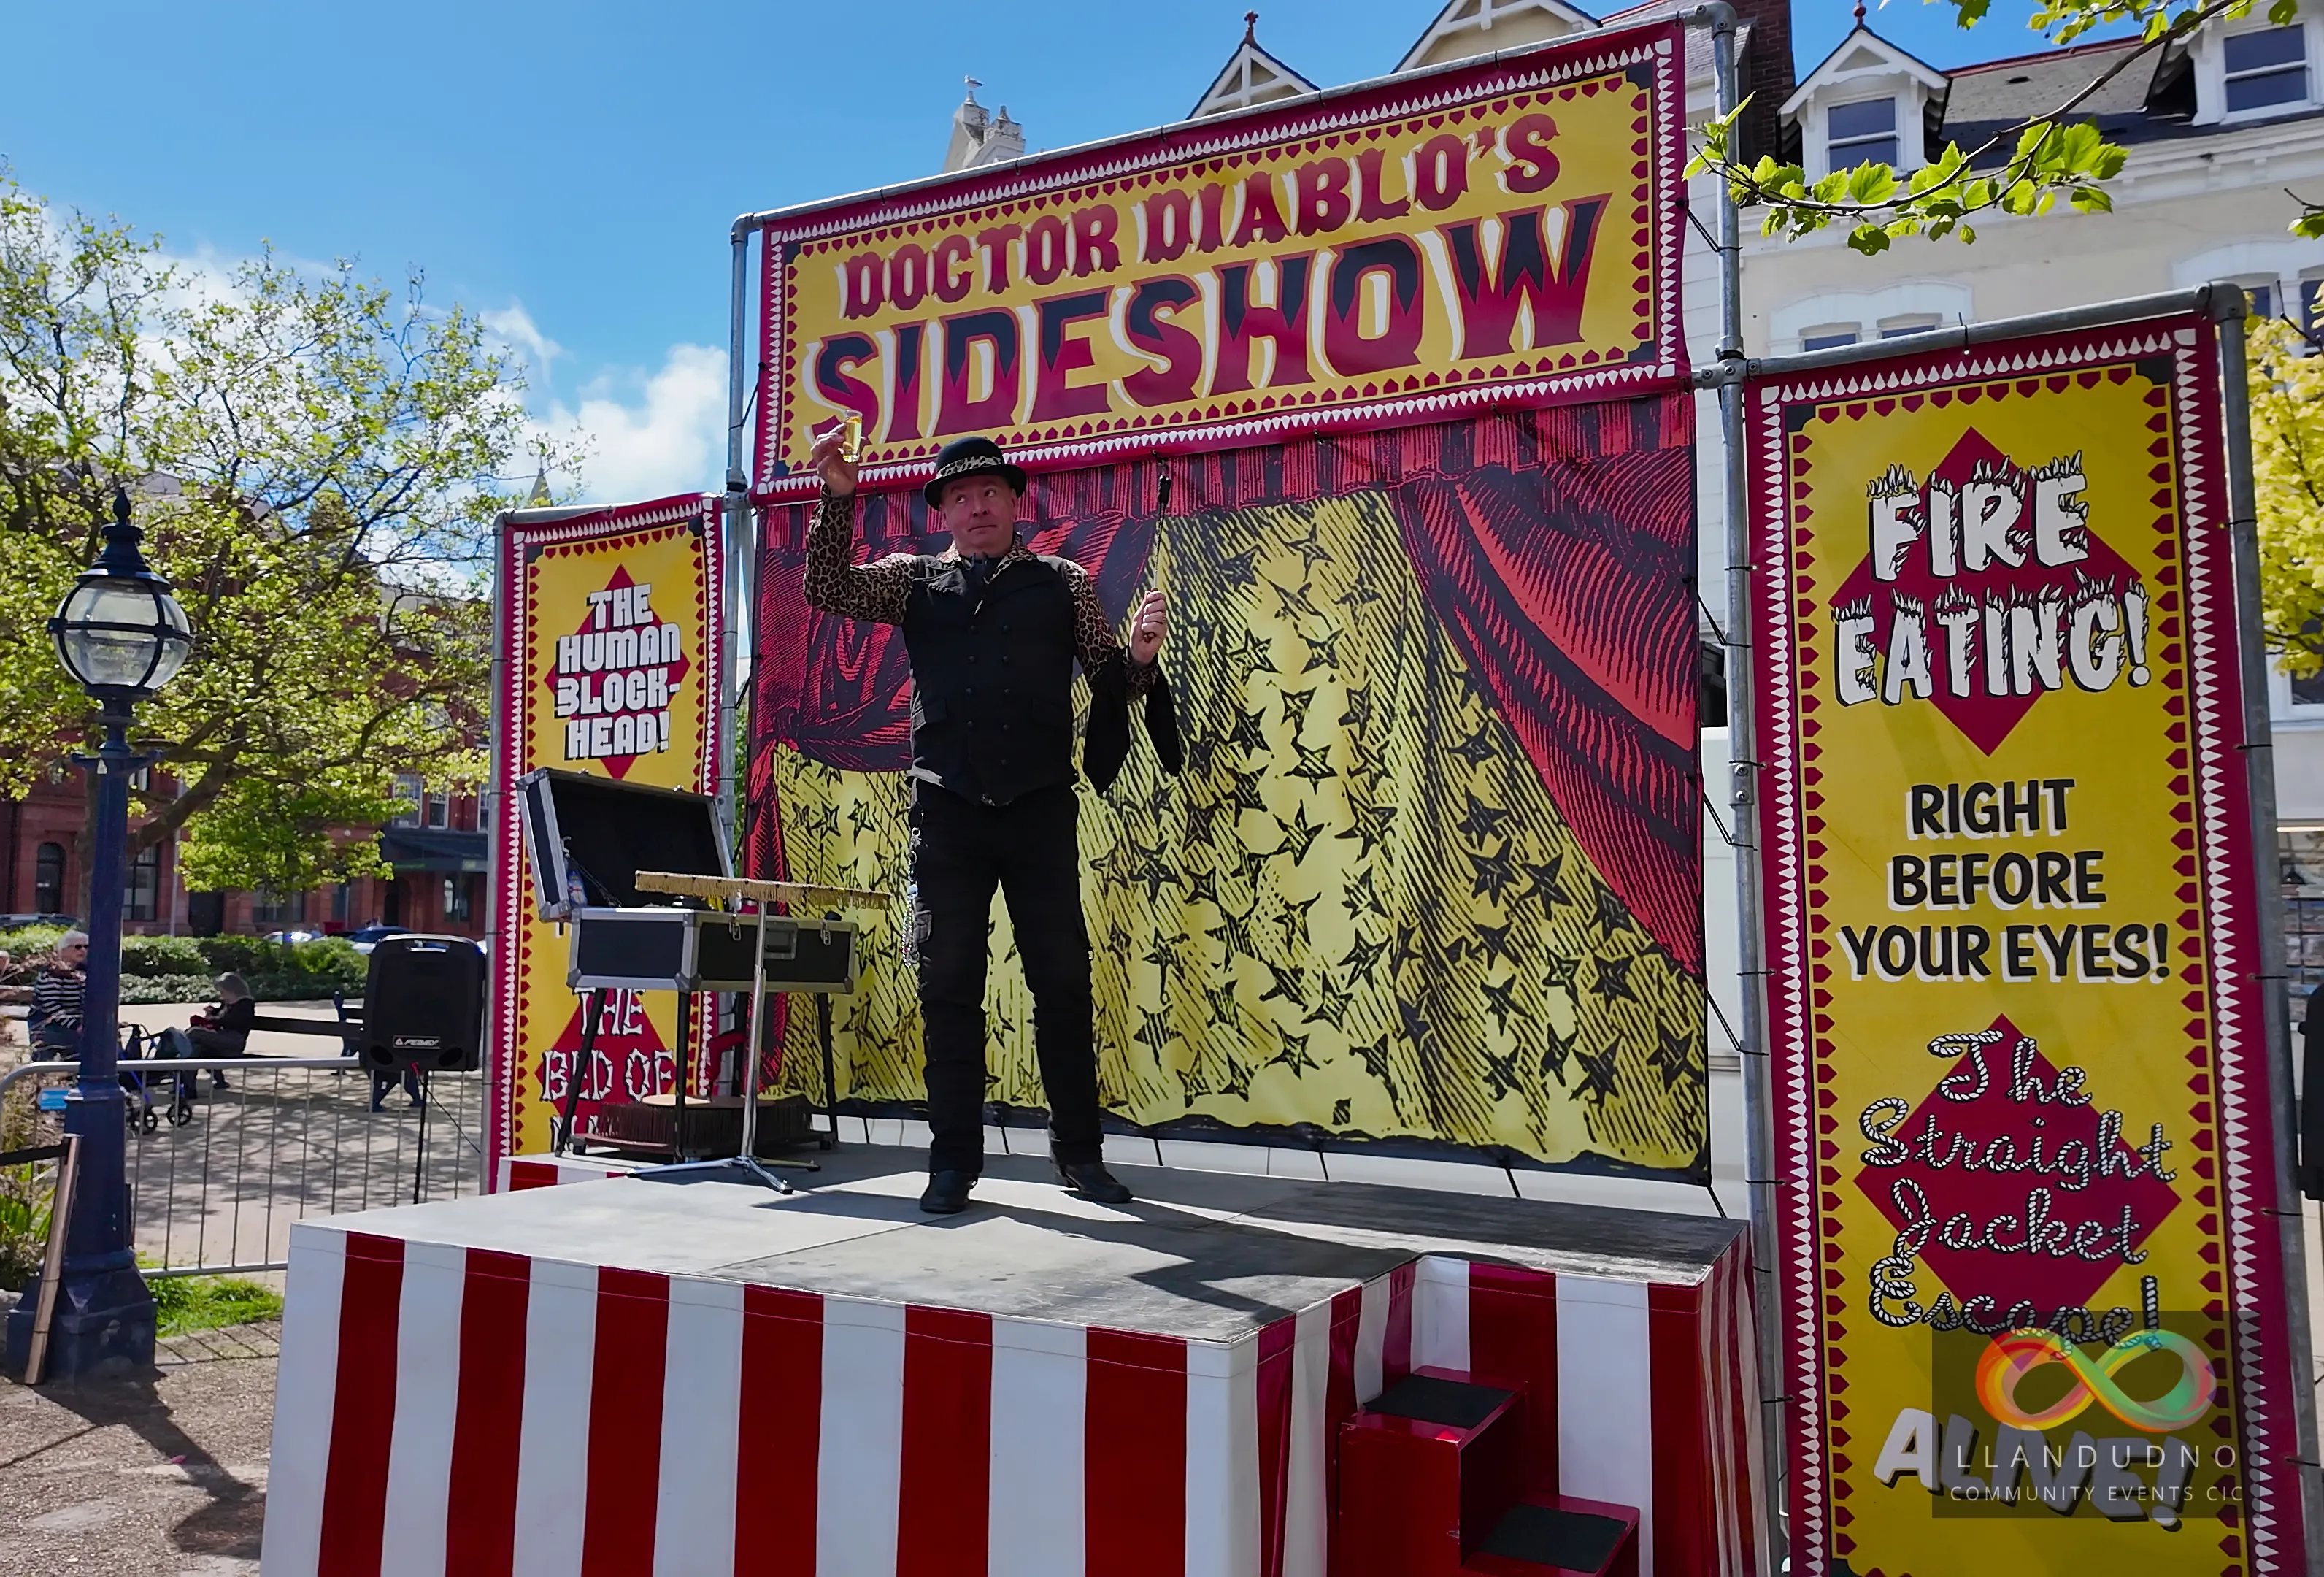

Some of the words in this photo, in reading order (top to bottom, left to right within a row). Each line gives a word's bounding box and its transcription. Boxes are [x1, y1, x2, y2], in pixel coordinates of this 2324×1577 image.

[834, 203, 1122, 320] DOCTOR
[803, 191, 1613, 447] SIDESHOW
[1866, 450, 2090, 582] FIRE
[587, 583, 654, 630] THE
[1831, 567, 2152, 707] EATING!
[555, 622, 681, 675] HUMAN
[554, 667, 681, 718] BLOCK-
[564, 710, 671, 761] HEAD!
[1906, 778, 2075, 840] RIGHT
[1888, 851, 2107, 911] BEFORE
[2000, 922, 2171, 984] EYES!
[572, 986, 646, 1036] THE
[624, 1048, 674, 1102] OF
[1927, 1029, 2093, 1104] The
[1859, 1097, 2178, 1193] Straight
[1890, 1177, 2150, 1265] Jacket
[1869, 1256, 2162, 1360] Escape!
[1873, 1407, 2192, 1532] ALIVE!
